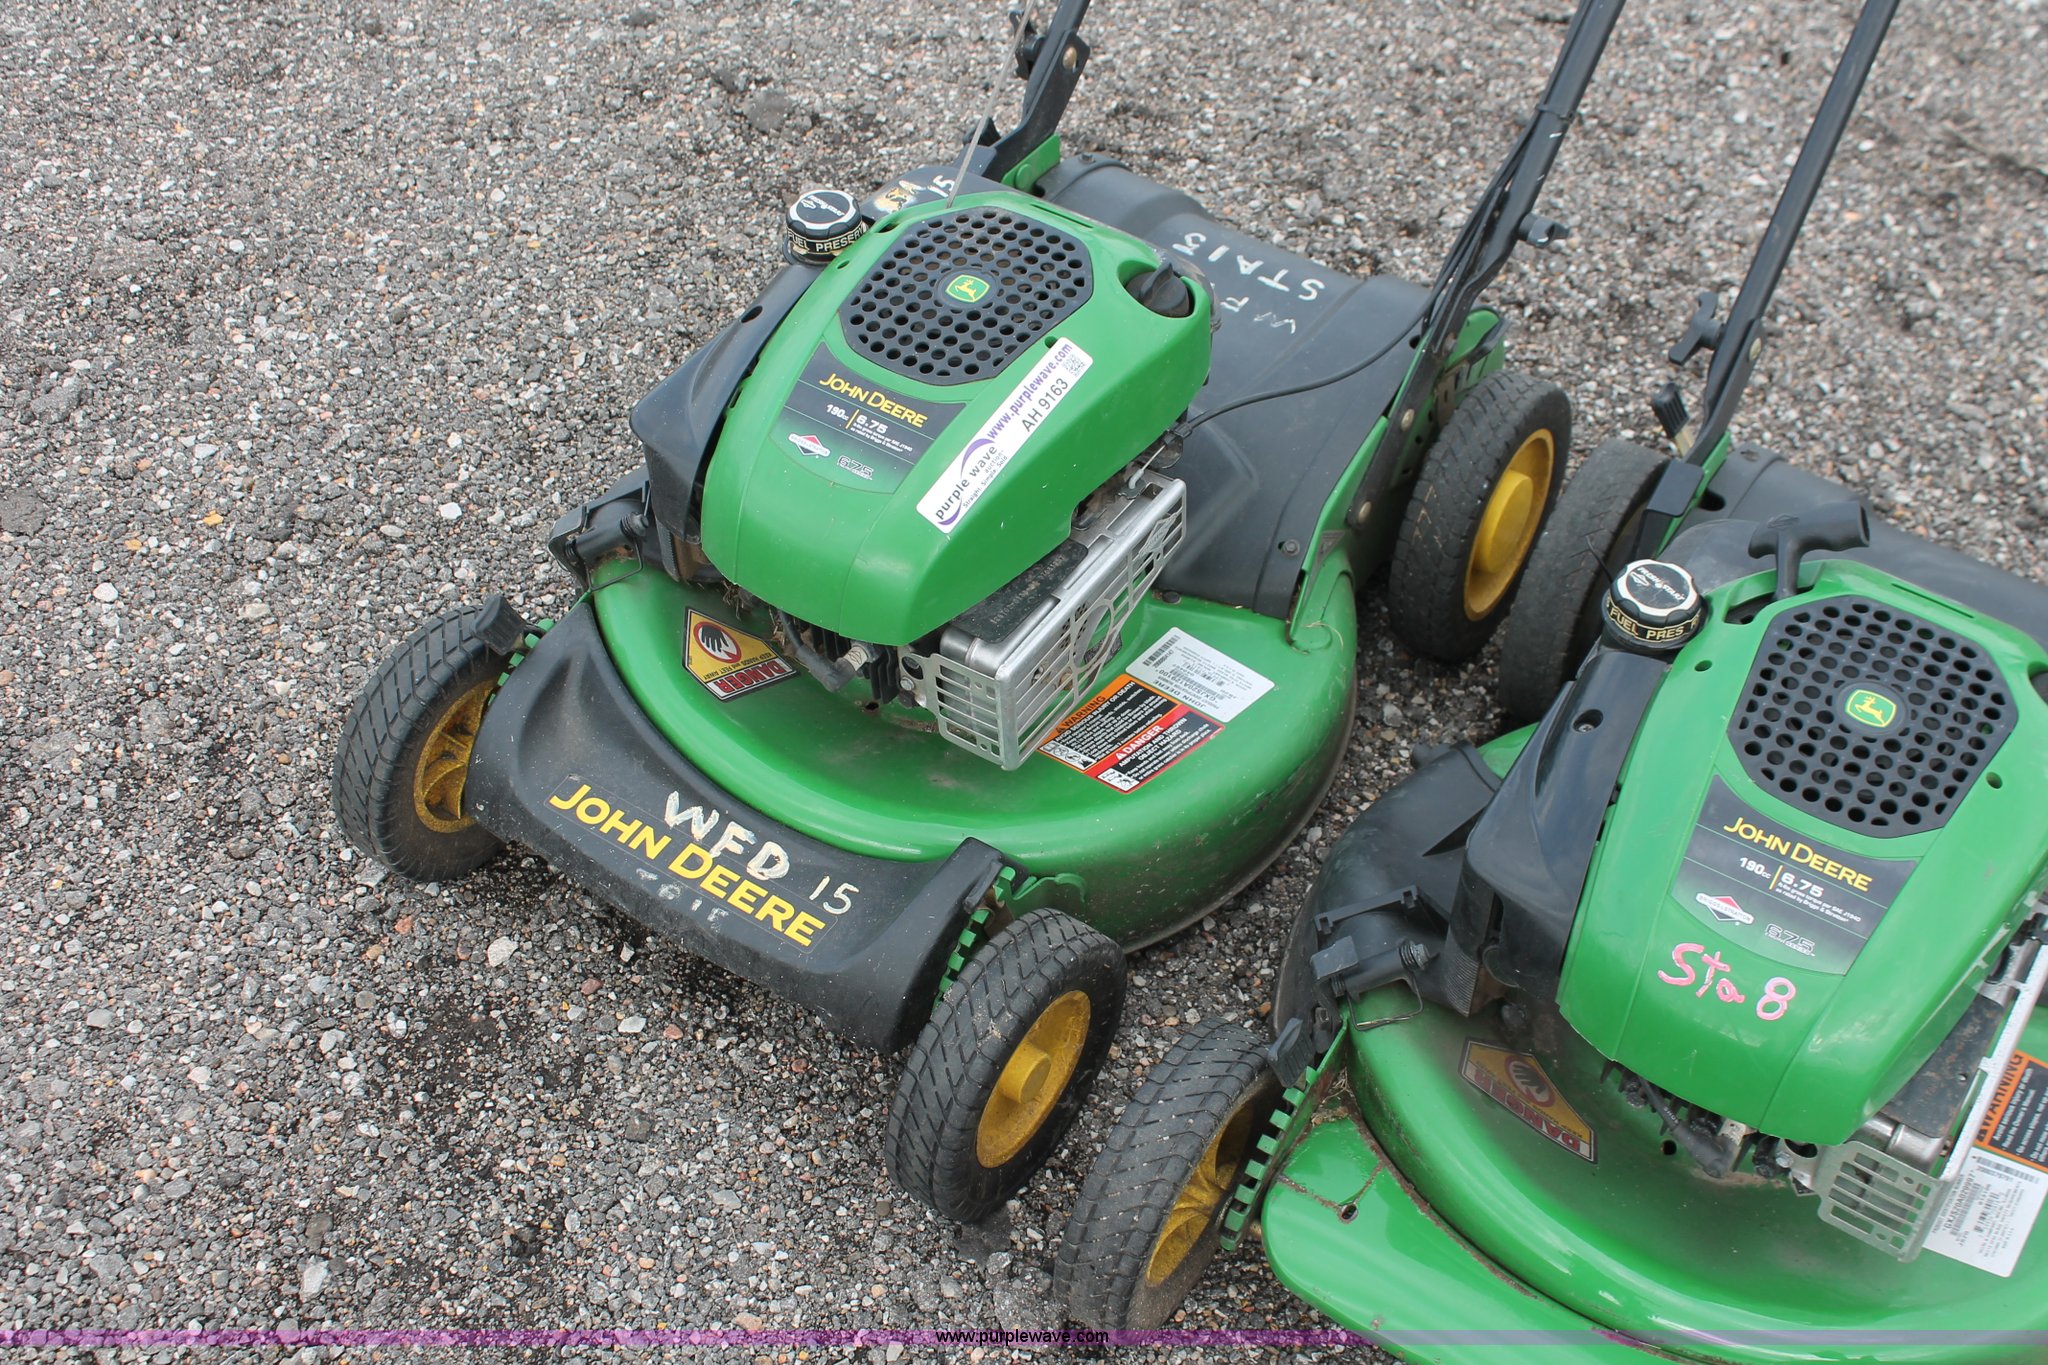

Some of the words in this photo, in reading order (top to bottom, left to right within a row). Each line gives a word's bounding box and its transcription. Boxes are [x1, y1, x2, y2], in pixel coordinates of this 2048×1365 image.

[787, 230, 810, 250] FUEL
[819, 373, 869, 402] JOHN
[867, 391, 928, 428] DEERE
[987, 343, 1073, 440] www.purplewave.com
[1021, 408, 1043, 432] AH
[1038, 378, 1068, 410] 9163
[856, 414, 889, 434] 6.75
[985, 452, 1003, 474] auction
[935, 478, 970, 520] purple
[969, 446, 998, 477] wave
[1610, 607, 1638, 635] FUEL
[713, 660, 787, 694] DANGER
[1062, 695, 1106, 731] WARNING
[1121, 724, 1165, 754] DANGER
[664, 791, 790, 881] WFD
[1723, 817, 1791, 855] JOHN
[1790, 842, 1872, 892] DEERE
[549, 784, 672, 860] JOHN
[668, 843, 826, 947] DEERE
[1739, 857, 1771, 879] 190cc
[809, 875, 860, 915] 15
[1781, 872, 1824, 898] 6.75
[1766, 922, 1816, 951] 675
[1756, 977, 1796, 1021] 8
[1474, 1068, 1580, 1150] DANGER
